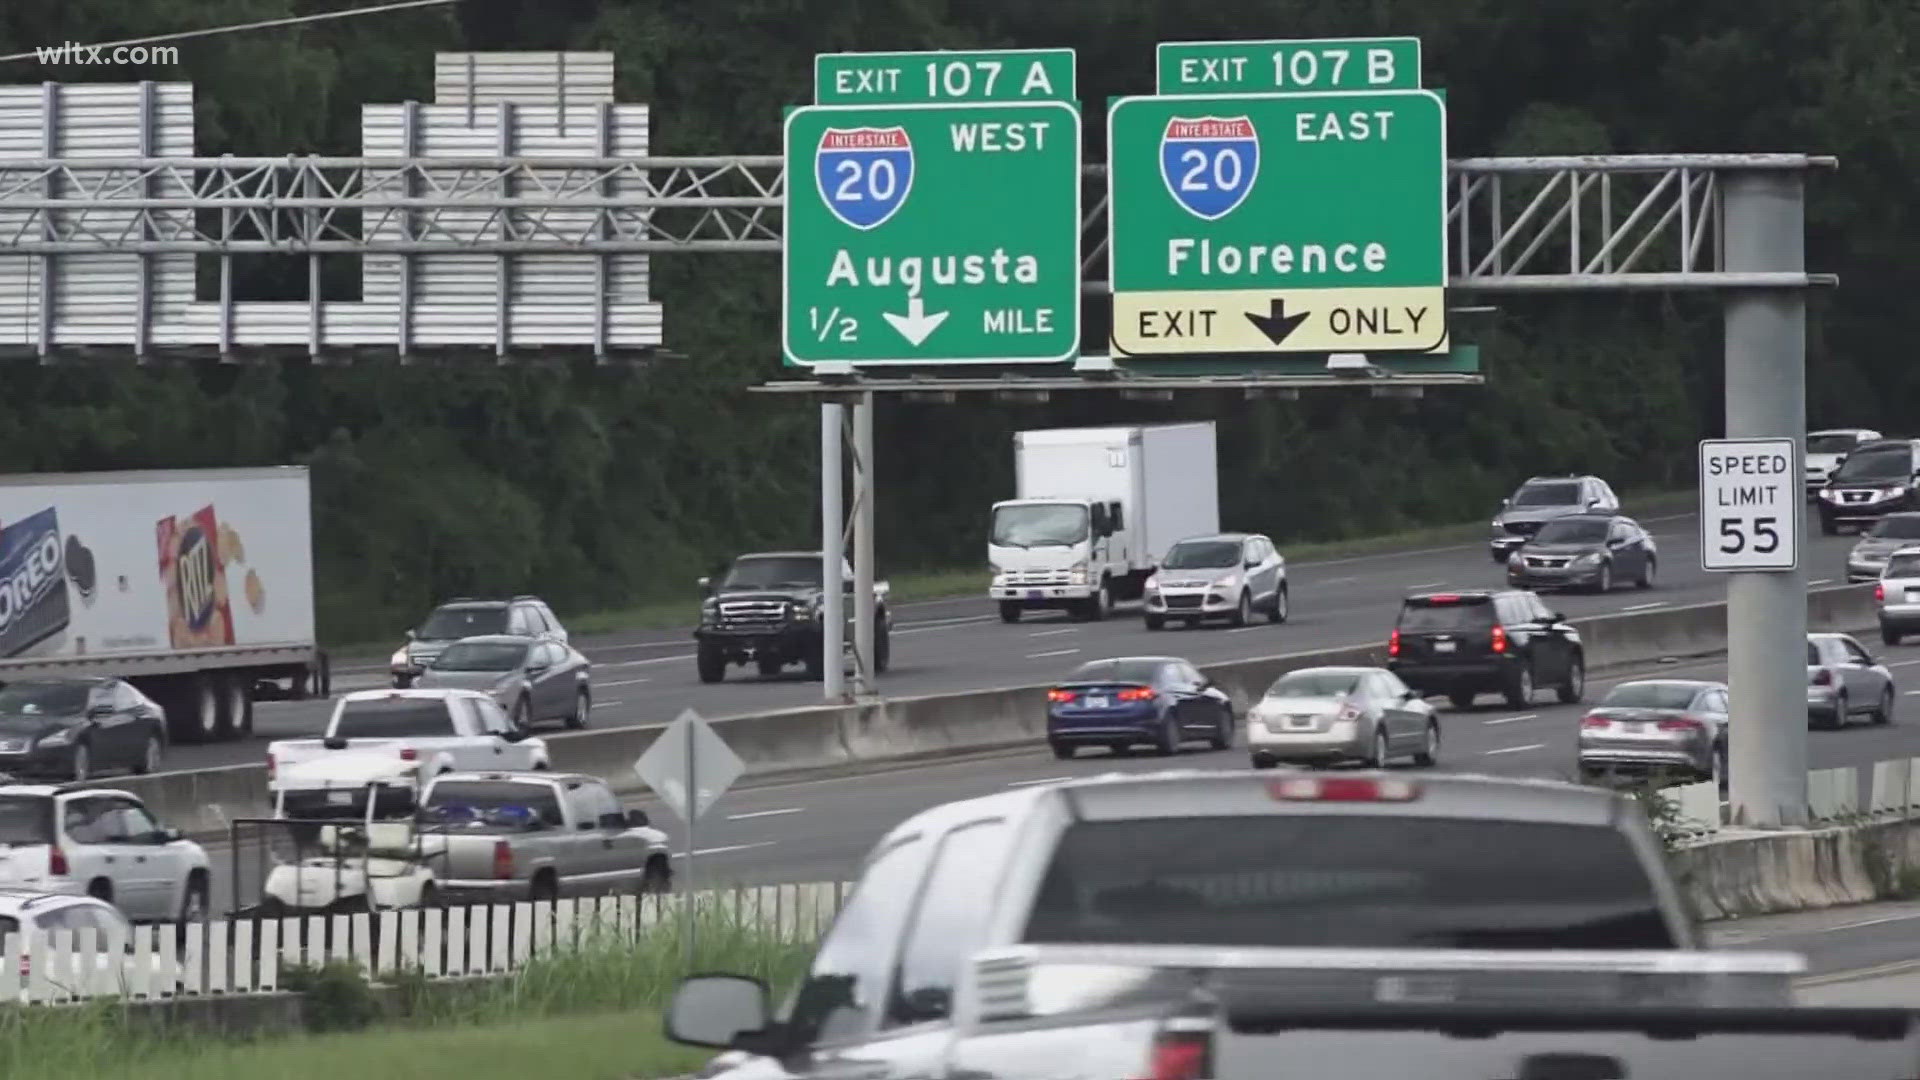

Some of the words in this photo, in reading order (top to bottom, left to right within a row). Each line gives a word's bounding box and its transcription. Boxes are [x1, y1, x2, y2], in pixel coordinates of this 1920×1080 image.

[836, 69, 902, 94] EXIT
[926, 61, 1002, 97] 107
[1021, 61, 1053, 95] A
[1181, 57, 1248, 83] EXIT
[1273, 50, 1349, 86] 107
[1368, 49, 1395, 84] B
[831, 133, 899, 147] INTERSTATE
[950, 122, 1050, 152] WEST
[1175, 123, 1244, 137] INTERSTATE
[1296, 111, 1394, 141] EAST
[835, 159, 896, 200] 20
[1181, 149, 1242, 191] 20
[826, 248, 1038, 297] Augusta
[1168, 238, 1387, 275] Florence
[810, 307, 858, 342] 1/2
[984, 309, 1054, 334] MILE
[1140, 310, 1217, 337] EXIT
[1329, 307, 1428, 335] ONLY
[1710, 455, 1787, 475] SPEED
[1719, 486, 1778, 506] LIMIT
[1720, 517, 1779, 554] 55
[0, 535, 60, 627] OREO
